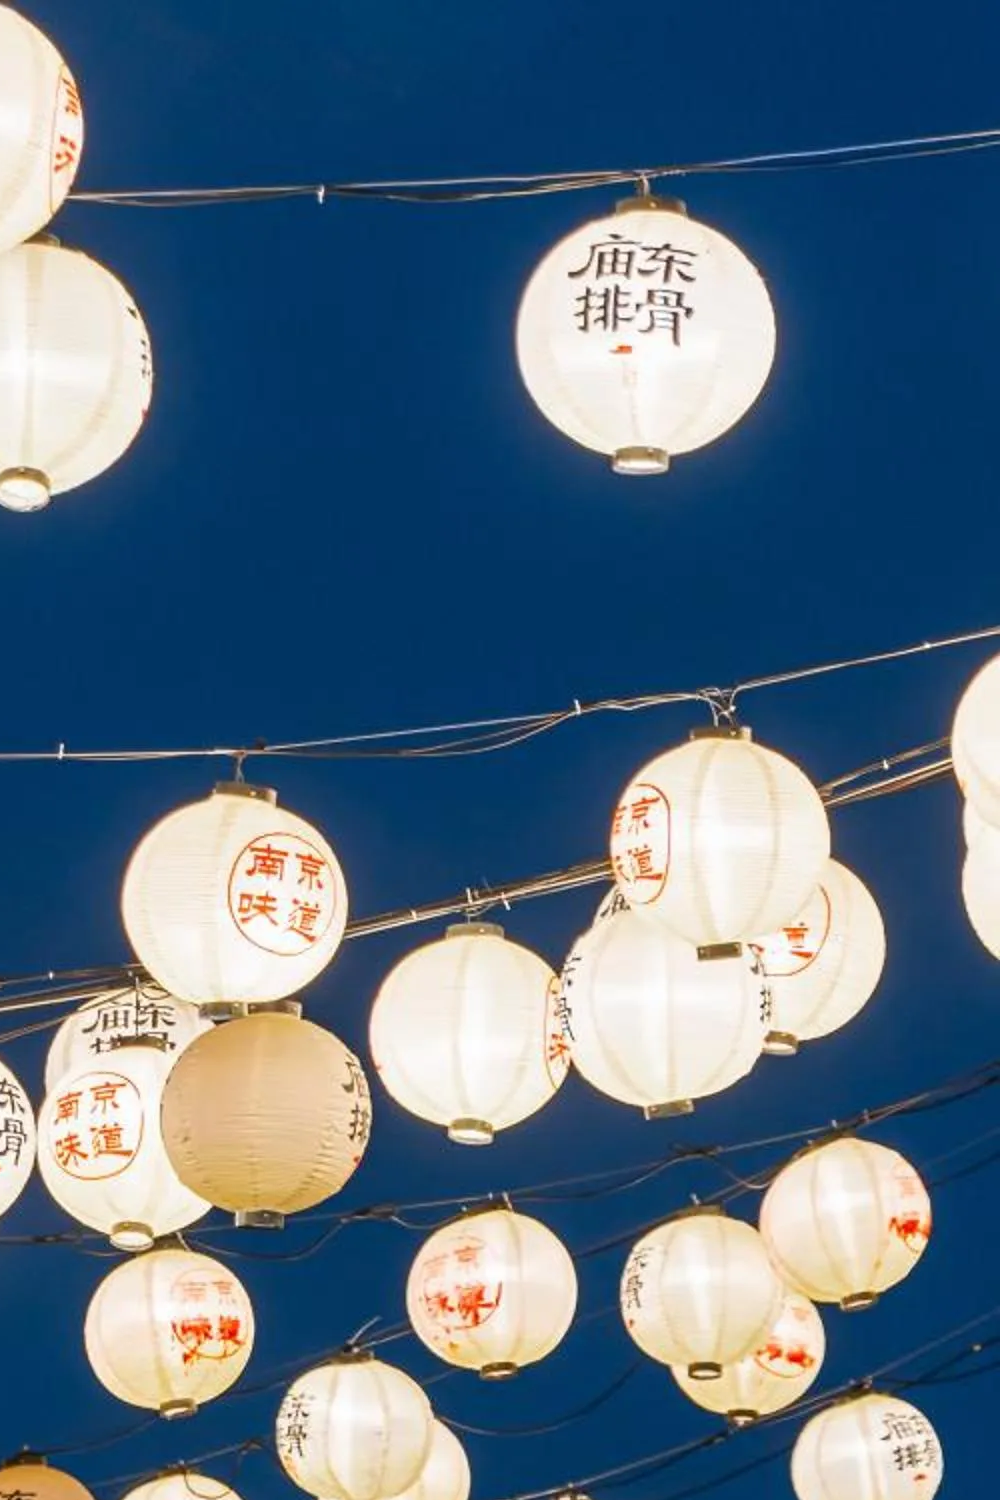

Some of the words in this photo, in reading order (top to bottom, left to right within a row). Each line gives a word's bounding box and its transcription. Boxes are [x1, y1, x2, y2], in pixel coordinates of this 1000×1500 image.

[568, 234, 698, 284] 庙东
[573, 284, 693, 346] 排骨
[245, 843, 327, 890] 南京
[236, 891, 325, 943] 味道
[54, 1081, 127, 1126] 南京
[55, 1123, 135, 1167] 味道
